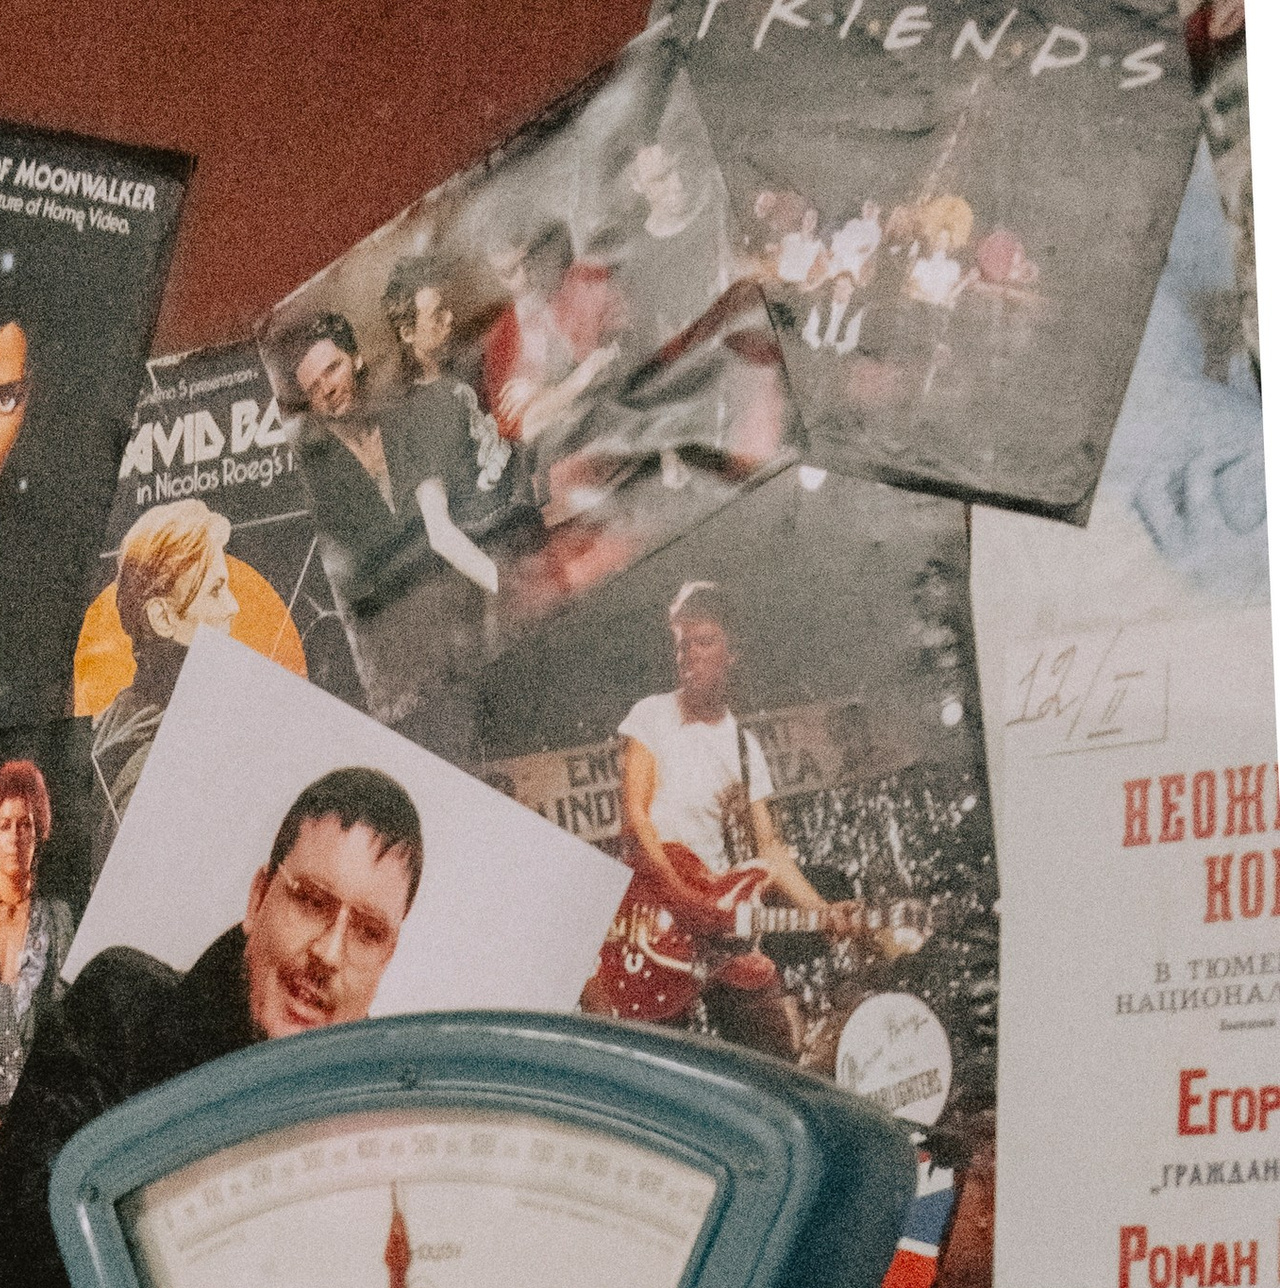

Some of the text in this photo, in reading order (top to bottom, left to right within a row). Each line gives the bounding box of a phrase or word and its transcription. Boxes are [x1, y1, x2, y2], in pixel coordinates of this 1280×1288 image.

[13, 159, 156, 212] MOONWALKER
[25, 197, 43, 216] of
[42, 199, 86, 226] Home
[119, 410, 225, 480] AVID
[136, 484, 152, 505] in
[156, 464, 220, 502] Nicolas
[222, 446, 283, 487] Roeg's
[1154, 951, 1280, 984] В ТЮМЕ
